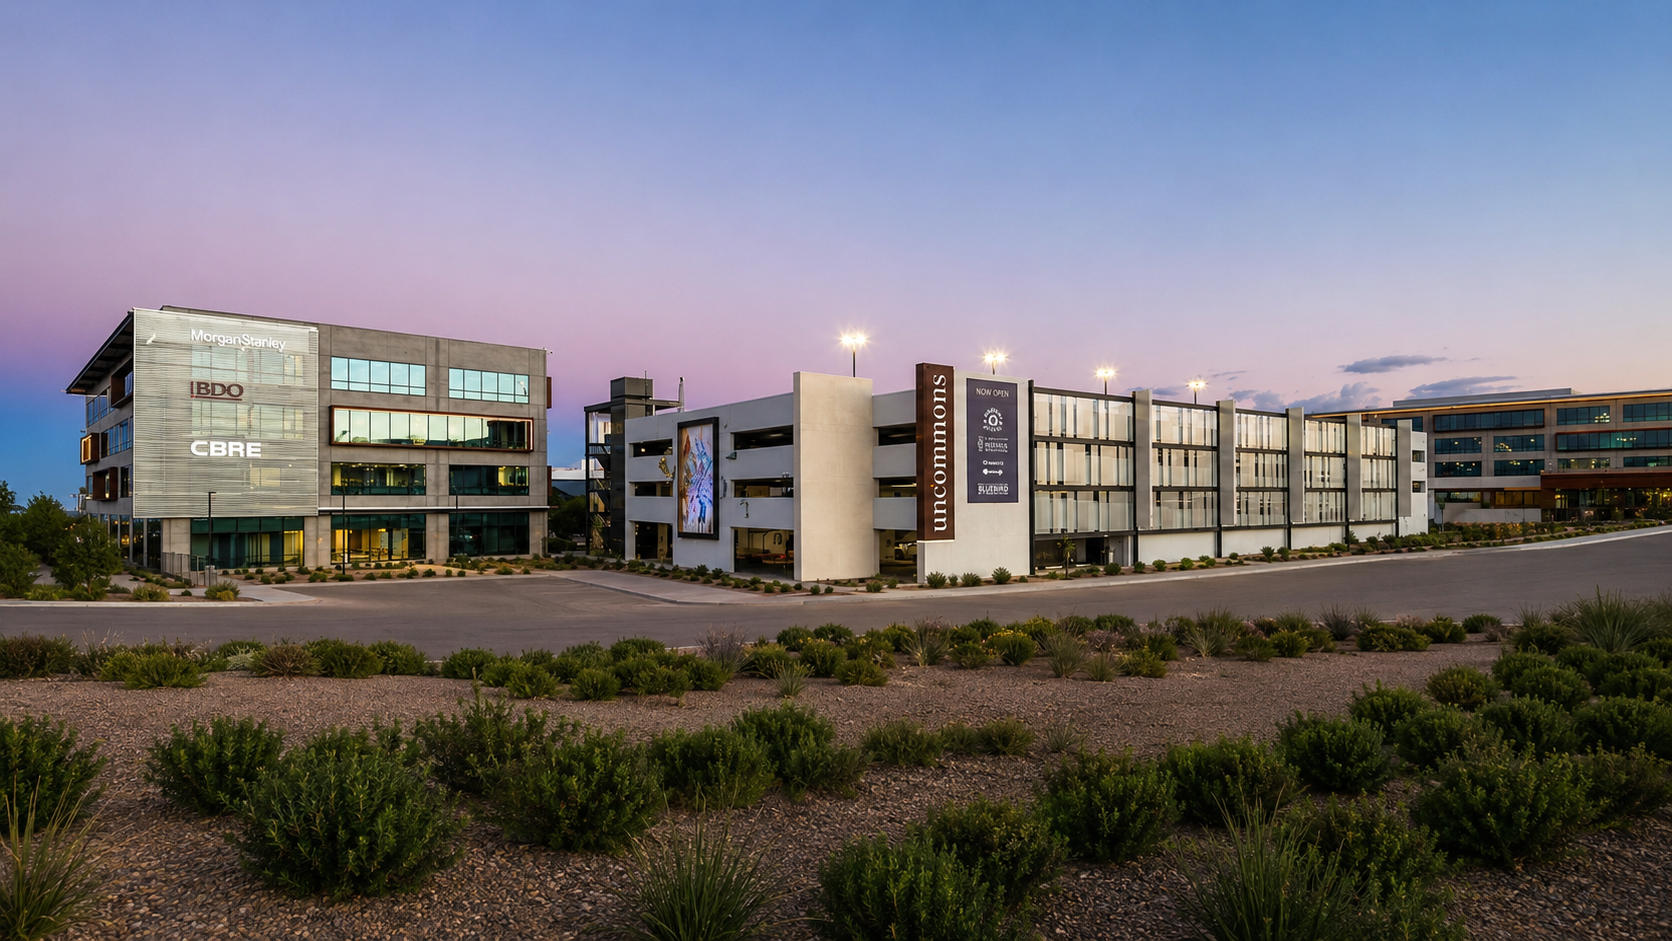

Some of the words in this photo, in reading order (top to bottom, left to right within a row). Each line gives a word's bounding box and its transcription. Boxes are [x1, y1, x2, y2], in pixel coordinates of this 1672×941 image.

[196, 381, 244, 398] BDO
[975, 387, 991, 396] NOW
[992, 389, 1010, 398] OPEN
[190, 440, 262, 457] CBRE
[933, 374, 947, 533] uncommons
